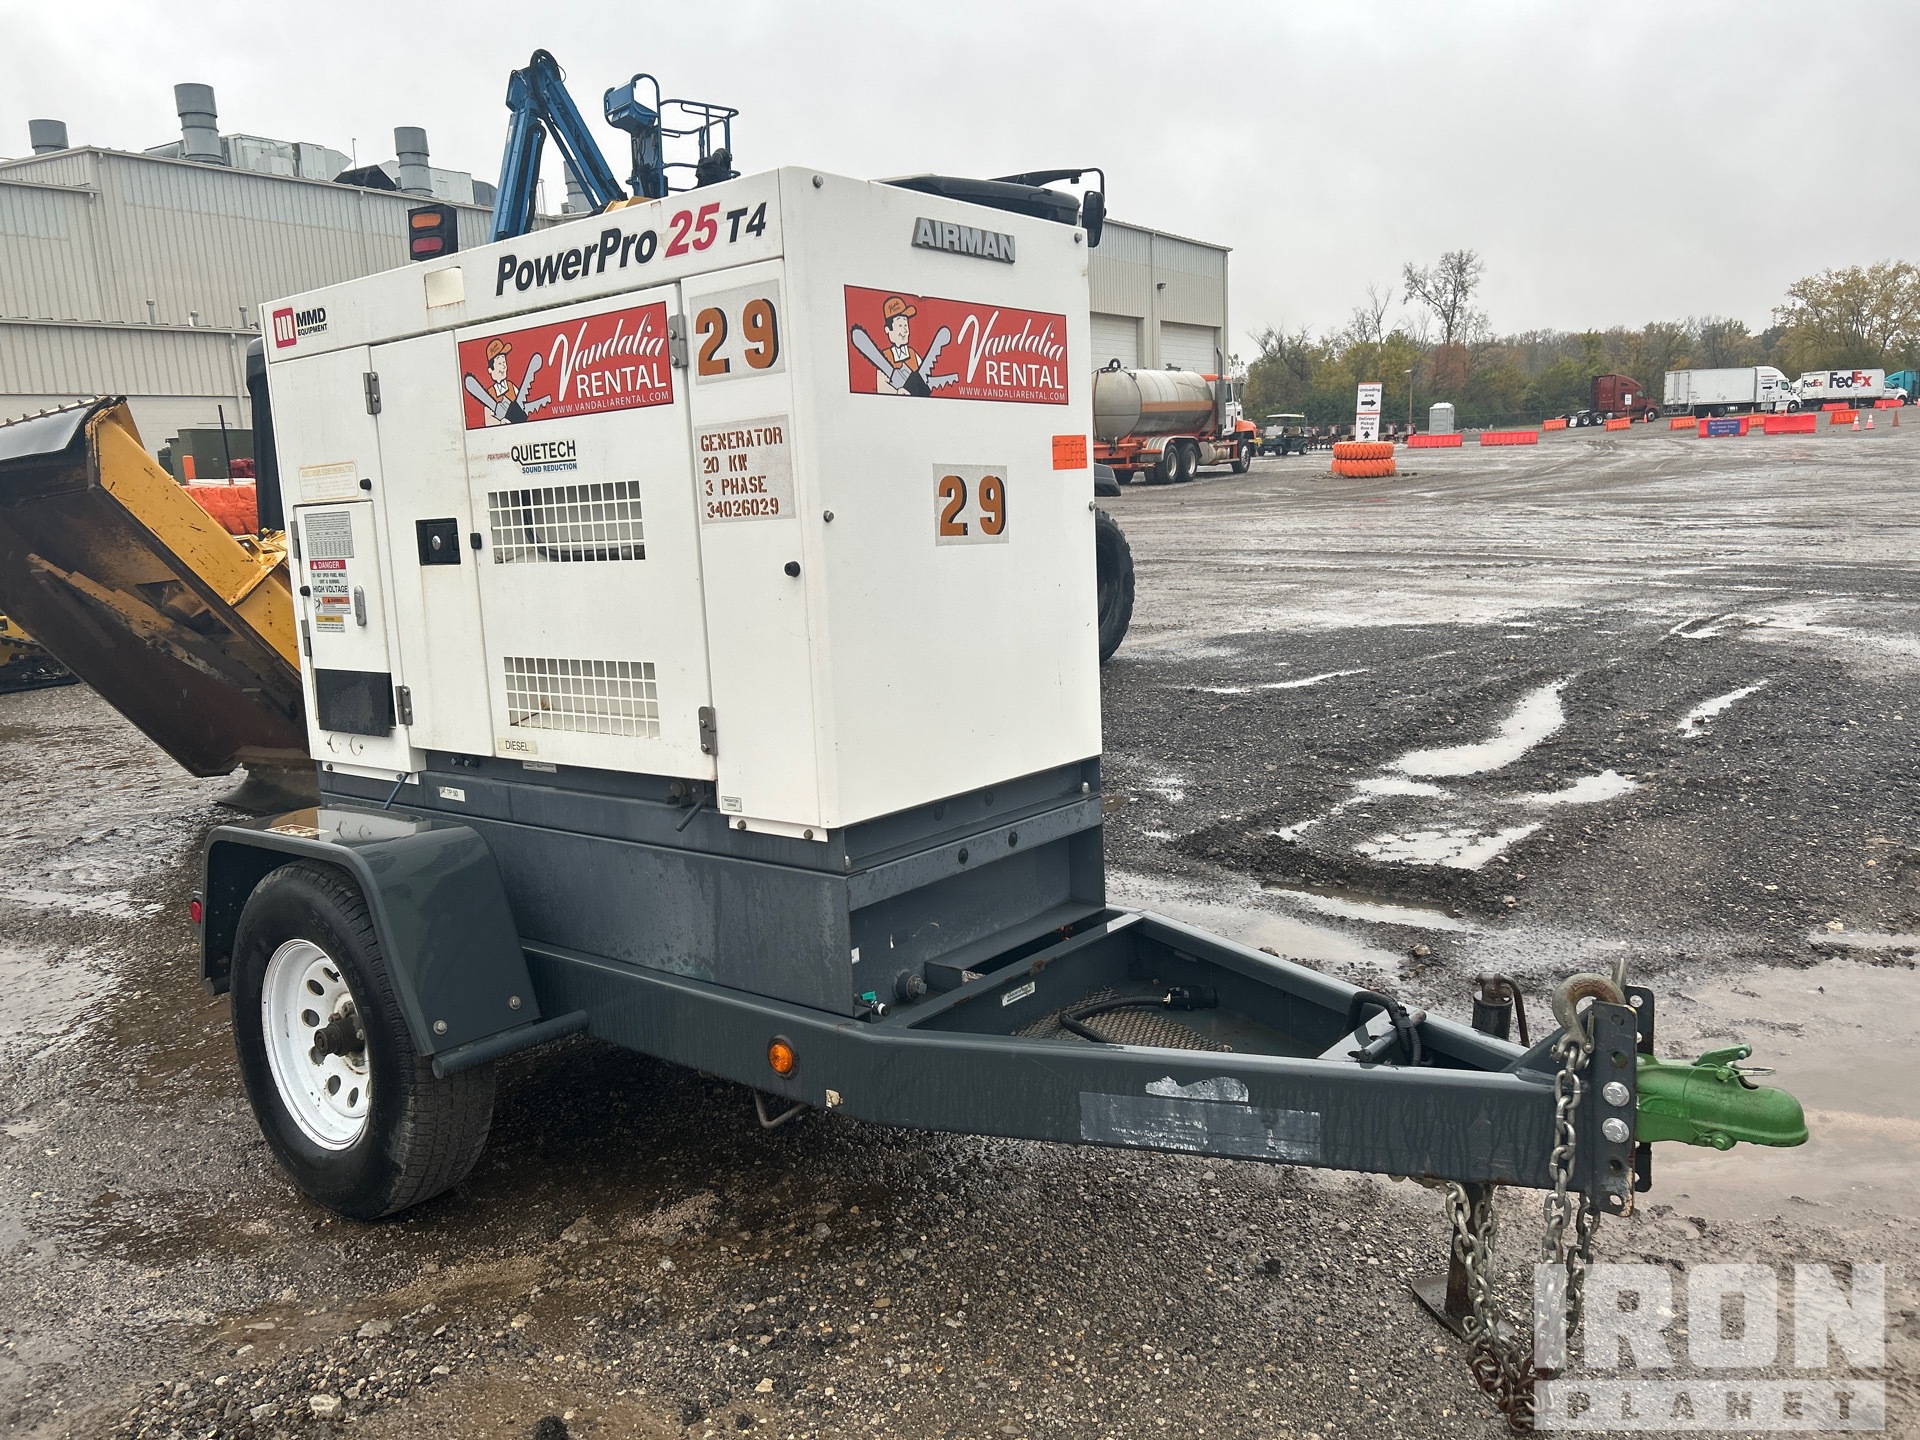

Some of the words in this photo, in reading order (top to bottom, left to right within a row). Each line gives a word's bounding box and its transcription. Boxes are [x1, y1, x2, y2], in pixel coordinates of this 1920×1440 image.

[495, 228, 658, 297] PowerPro
[664, 203, 721, 259] 25
[726, 202, 767, 244] T4
[916, 219, 1015, 263] AIRMAN
[296, 307, 326, 328] MMD
[297, 323, 328, 337] EQUIPMENT
[548, 312, 665, 402] Vandalia
[957, 310, 1064, 384] Vandalia
[576, 362, 667, 399] RENTAL
[985, 360, 1065, 390] RENTAL
[1803, 379, 1824, 388] FedEx
[1829, 371, 1873, 389] FedEx
[551, 391, 669, 415] WWW.VANDALIARENTAL.COM
[958, 386, 1066, 401] WWW.VANDALIARENTAL.COM
[700, 426, 783, 452] GENERATOR
[487, 452, 511, 460] FEATURING
[511, 439, 577, 463] QUIETECH
[521, 465, 542, 474] SOUND
[543, 463, 578, 472] REDUCTION
[703, 456, 720, 474] 20
[705, 479, 714, 496] 3
[721, 475, 768, 496] PHASE
[707, 497, 779, 519] 34026029
[317, 561, 340, 569] DANGER
[325, 585, 348, 593] VOLTAGE
[505, 740, 530, 752] DIESEL
